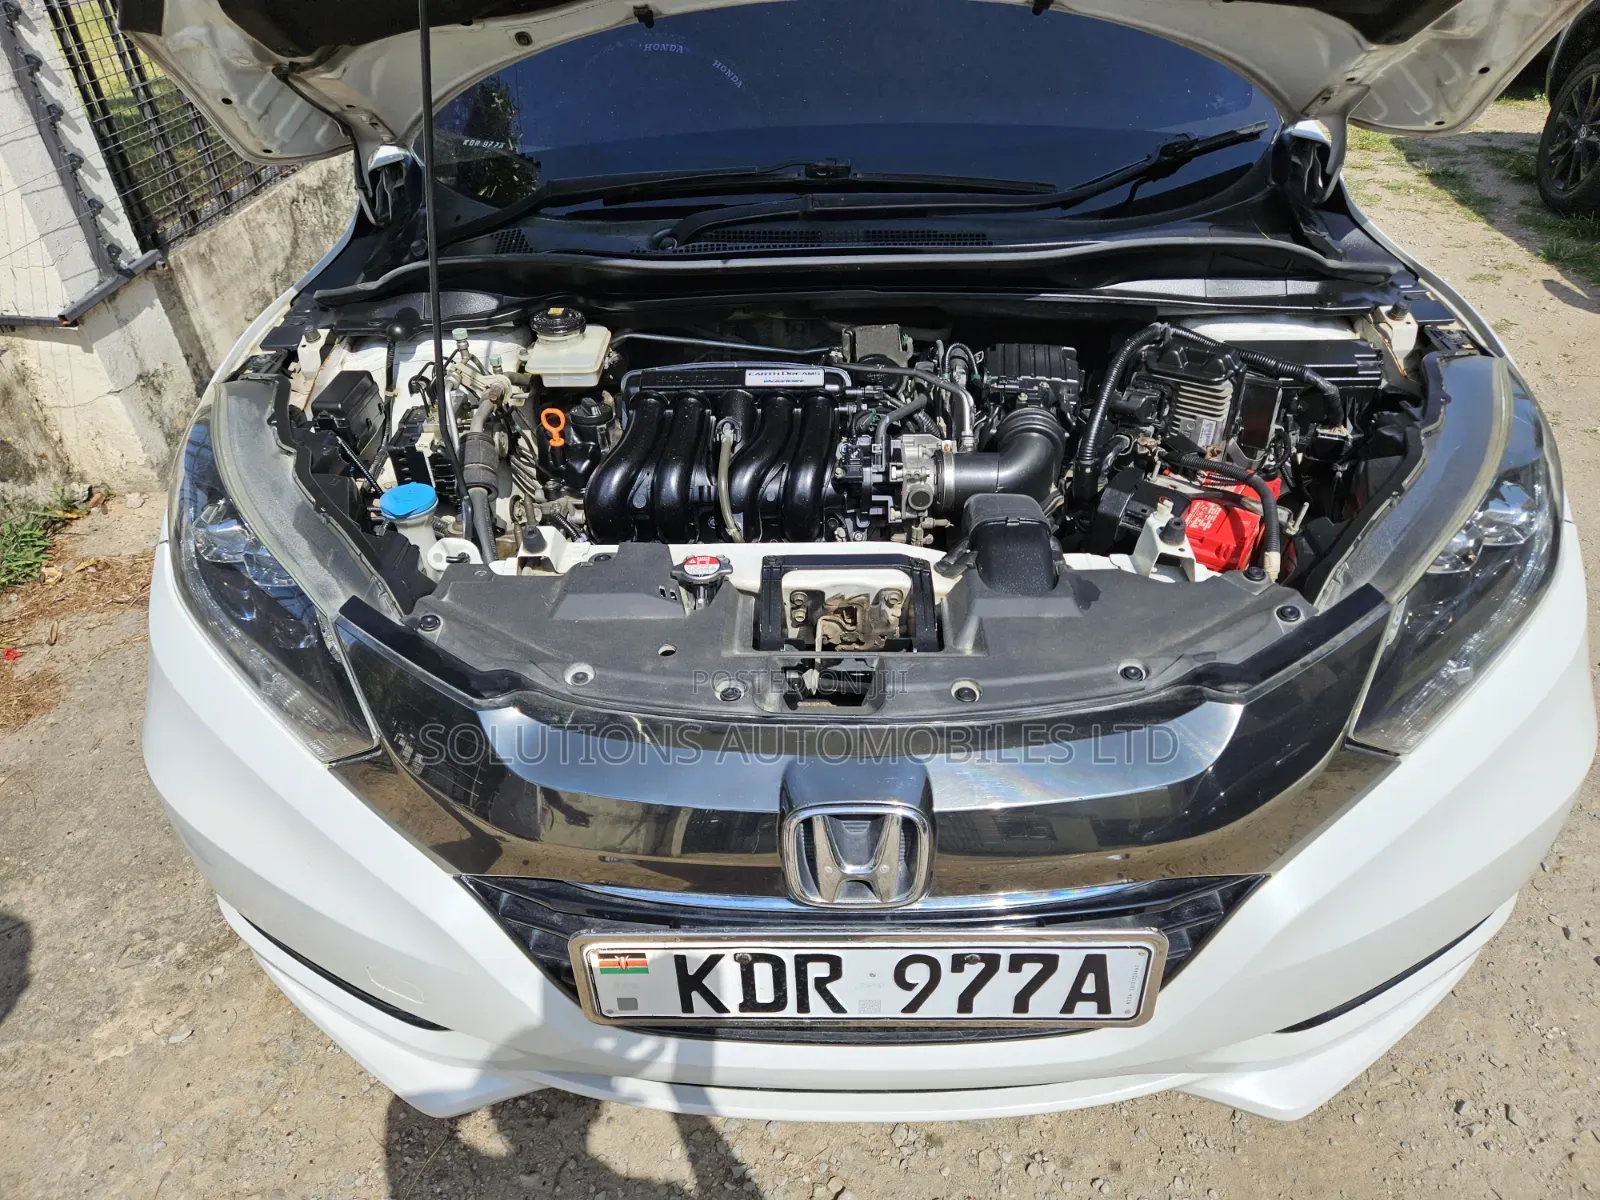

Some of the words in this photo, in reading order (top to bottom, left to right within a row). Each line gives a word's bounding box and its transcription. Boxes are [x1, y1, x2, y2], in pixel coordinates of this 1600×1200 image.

[644, 43, 684, 53] HONDA
[712, 59, 743, 88] HONDA
[673, 953, 848, 1014] KDR
[893, 953, 1112, 1014] 977A
